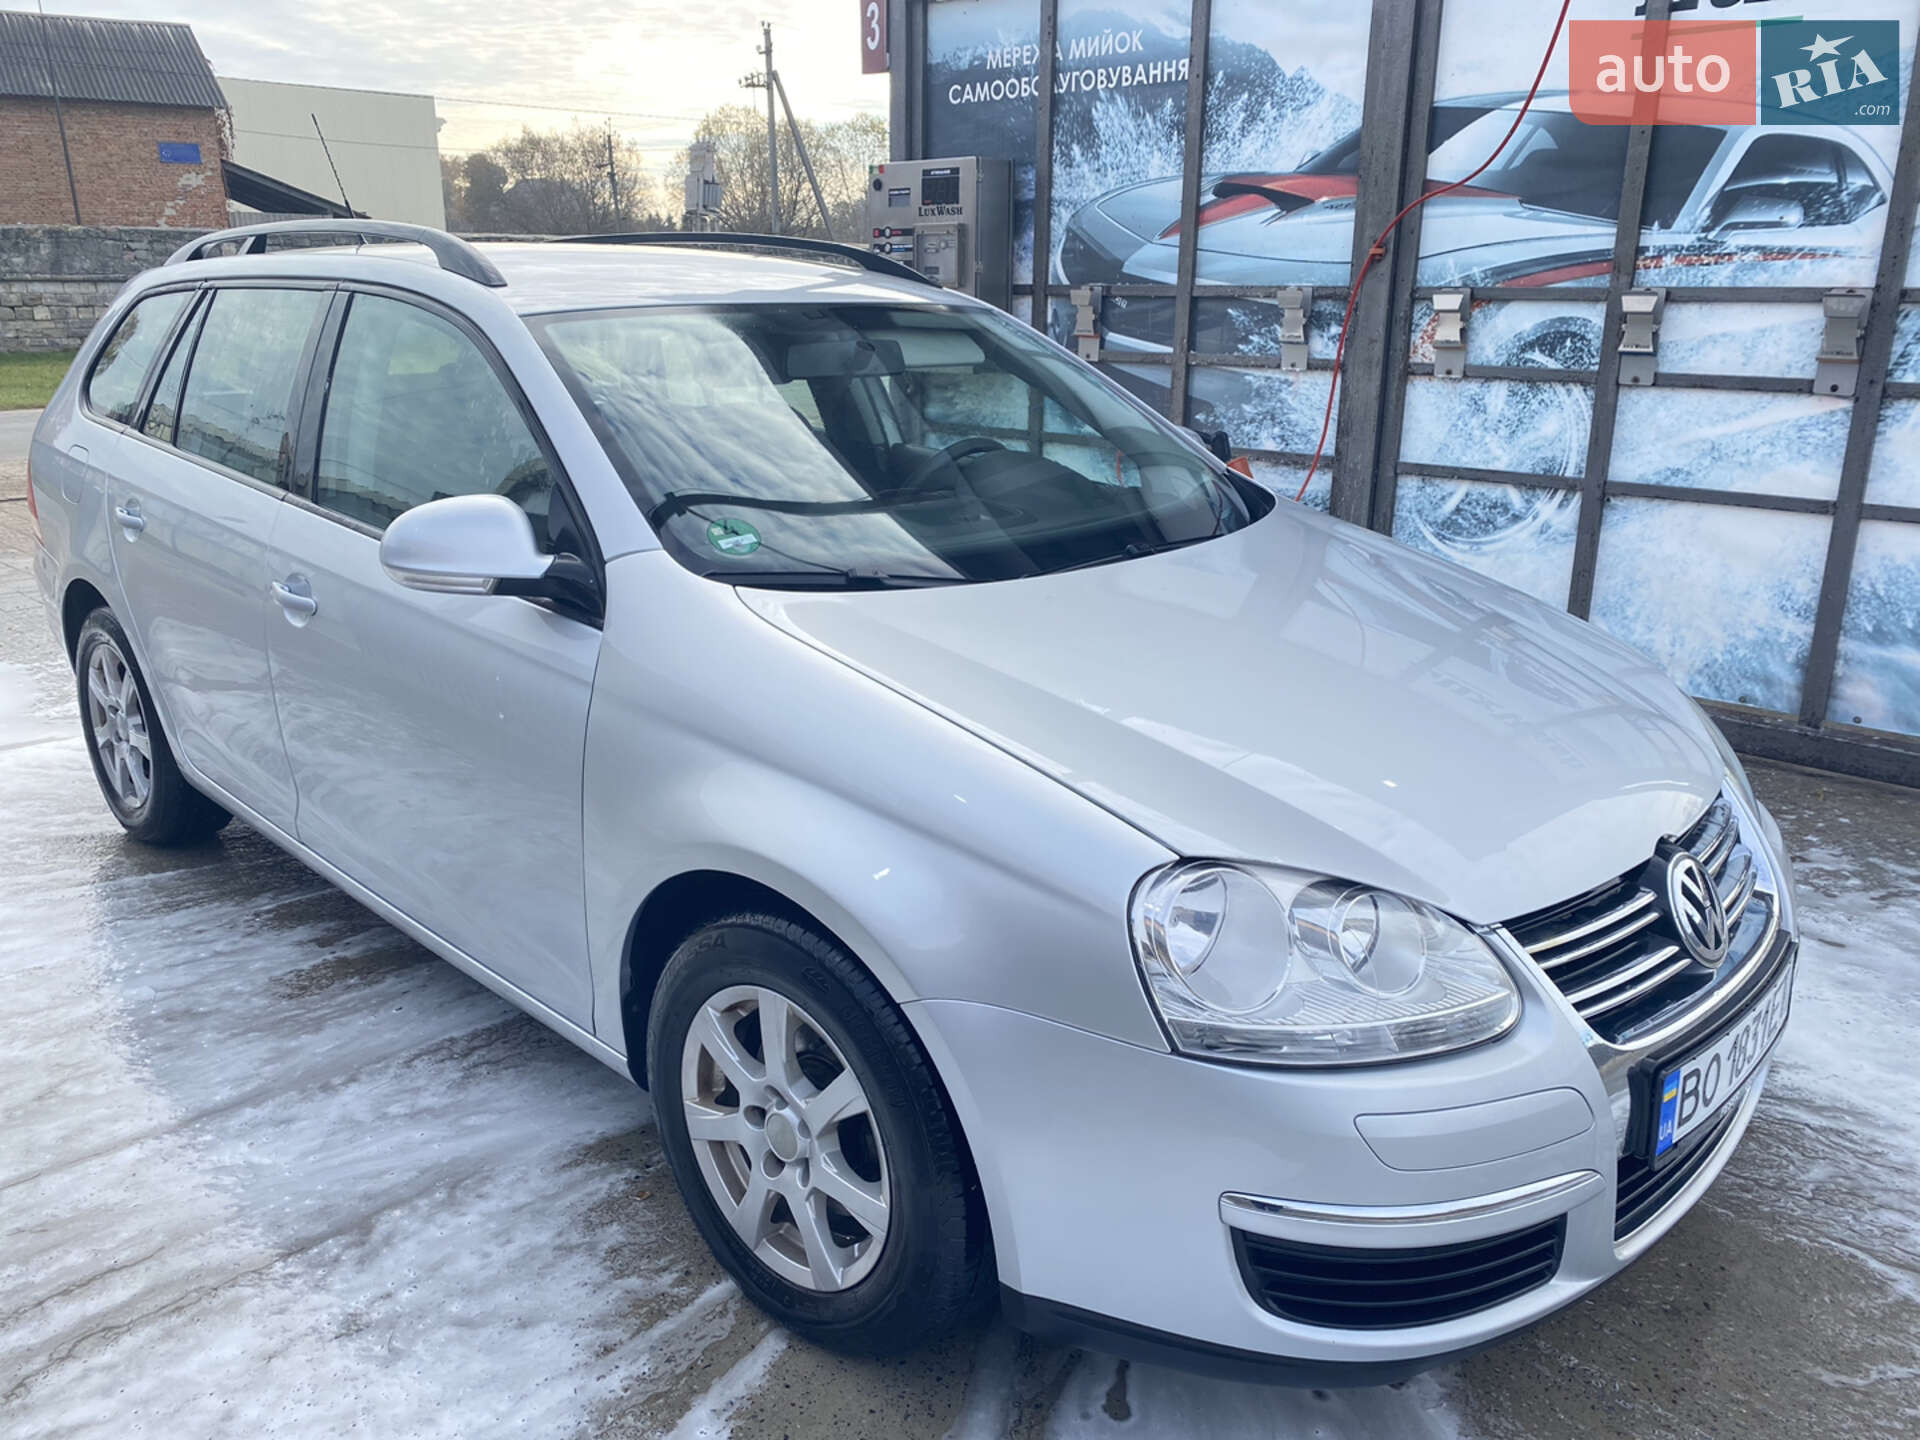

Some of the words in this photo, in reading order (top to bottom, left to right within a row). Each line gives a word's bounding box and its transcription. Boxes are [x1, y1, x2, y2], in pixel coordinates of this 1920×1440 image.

[866, 1, 881, 50] 3
[1068, 28, 1144, 60] МИЙОК
[948, 57, 1189, 105] САМООБСУГОВУВАННЯ
[1677, 1051, 1721, 1130] BO
[1659, 1119, 1674, 1141] UA
